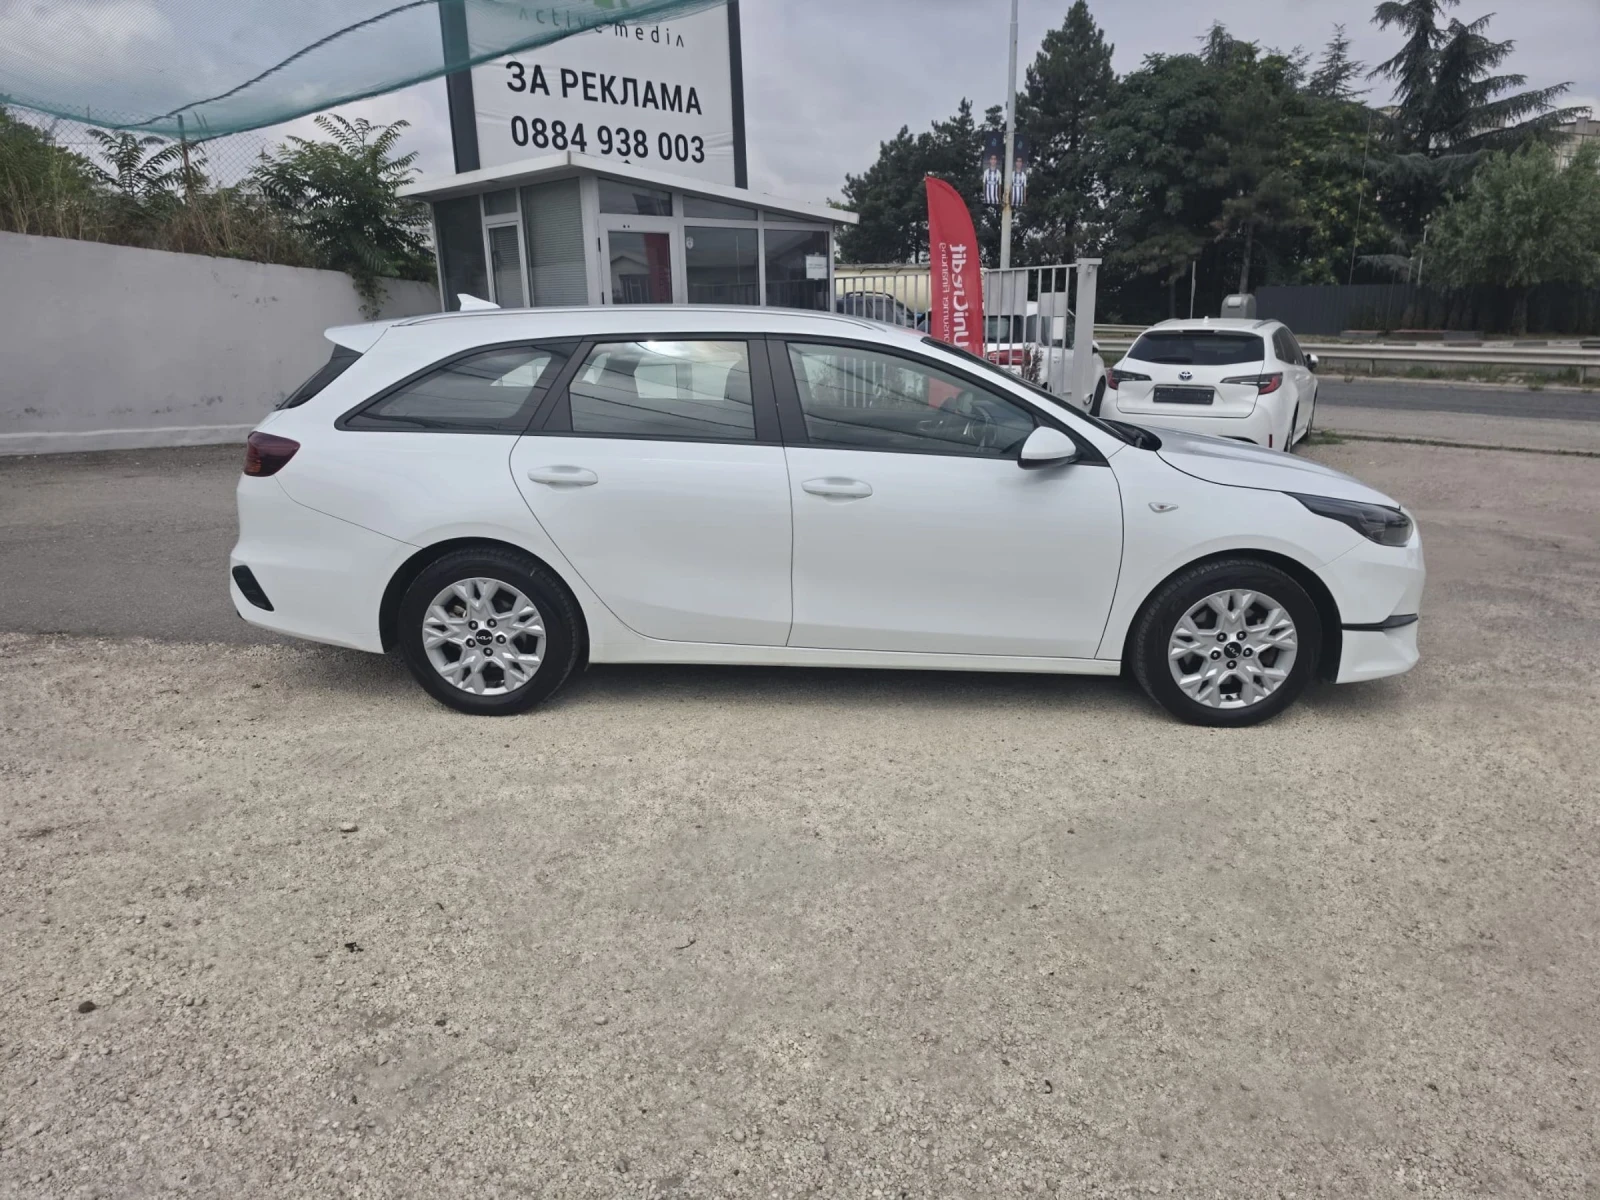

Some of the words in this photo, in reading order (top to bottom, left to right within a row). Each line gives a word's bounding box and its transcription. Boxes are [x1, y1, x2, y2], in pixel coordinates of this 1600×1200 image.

[505, 60, 550, 96] ЗА
[560, 68, 702, 115] РЕКЛАМА
[511, 115, 587, 152] 0884
[597, 125, 648, 158] 938
[658, 132, 705, 163] 003
